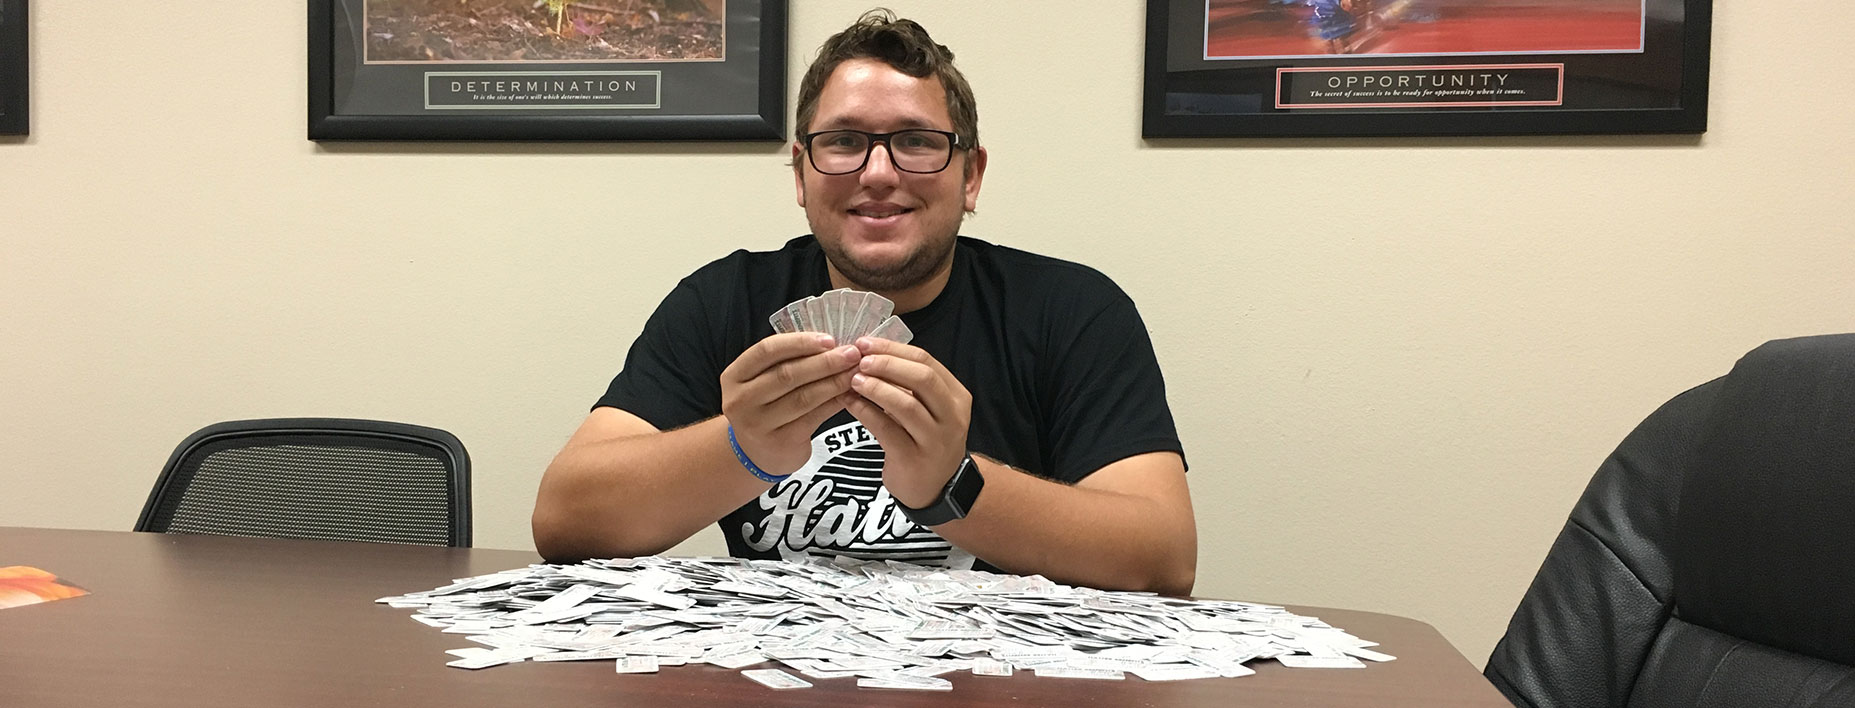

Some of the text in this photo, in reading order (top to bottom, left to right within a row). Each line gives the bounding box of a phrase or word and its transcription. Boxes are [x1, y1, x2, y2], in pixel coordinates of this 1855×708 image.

[451, 80, 636, 92] DETERMINATION
[1328, 73, 1508, 88] OPPORTUNITY
[1344, 90, 1352, 98] of
[1402, 89, 1421, 97] ready
[1422, 89, 1433, 97] for
[1434, 88, 1475, 97] opportunity
[825, 425, 876, 453] STE
